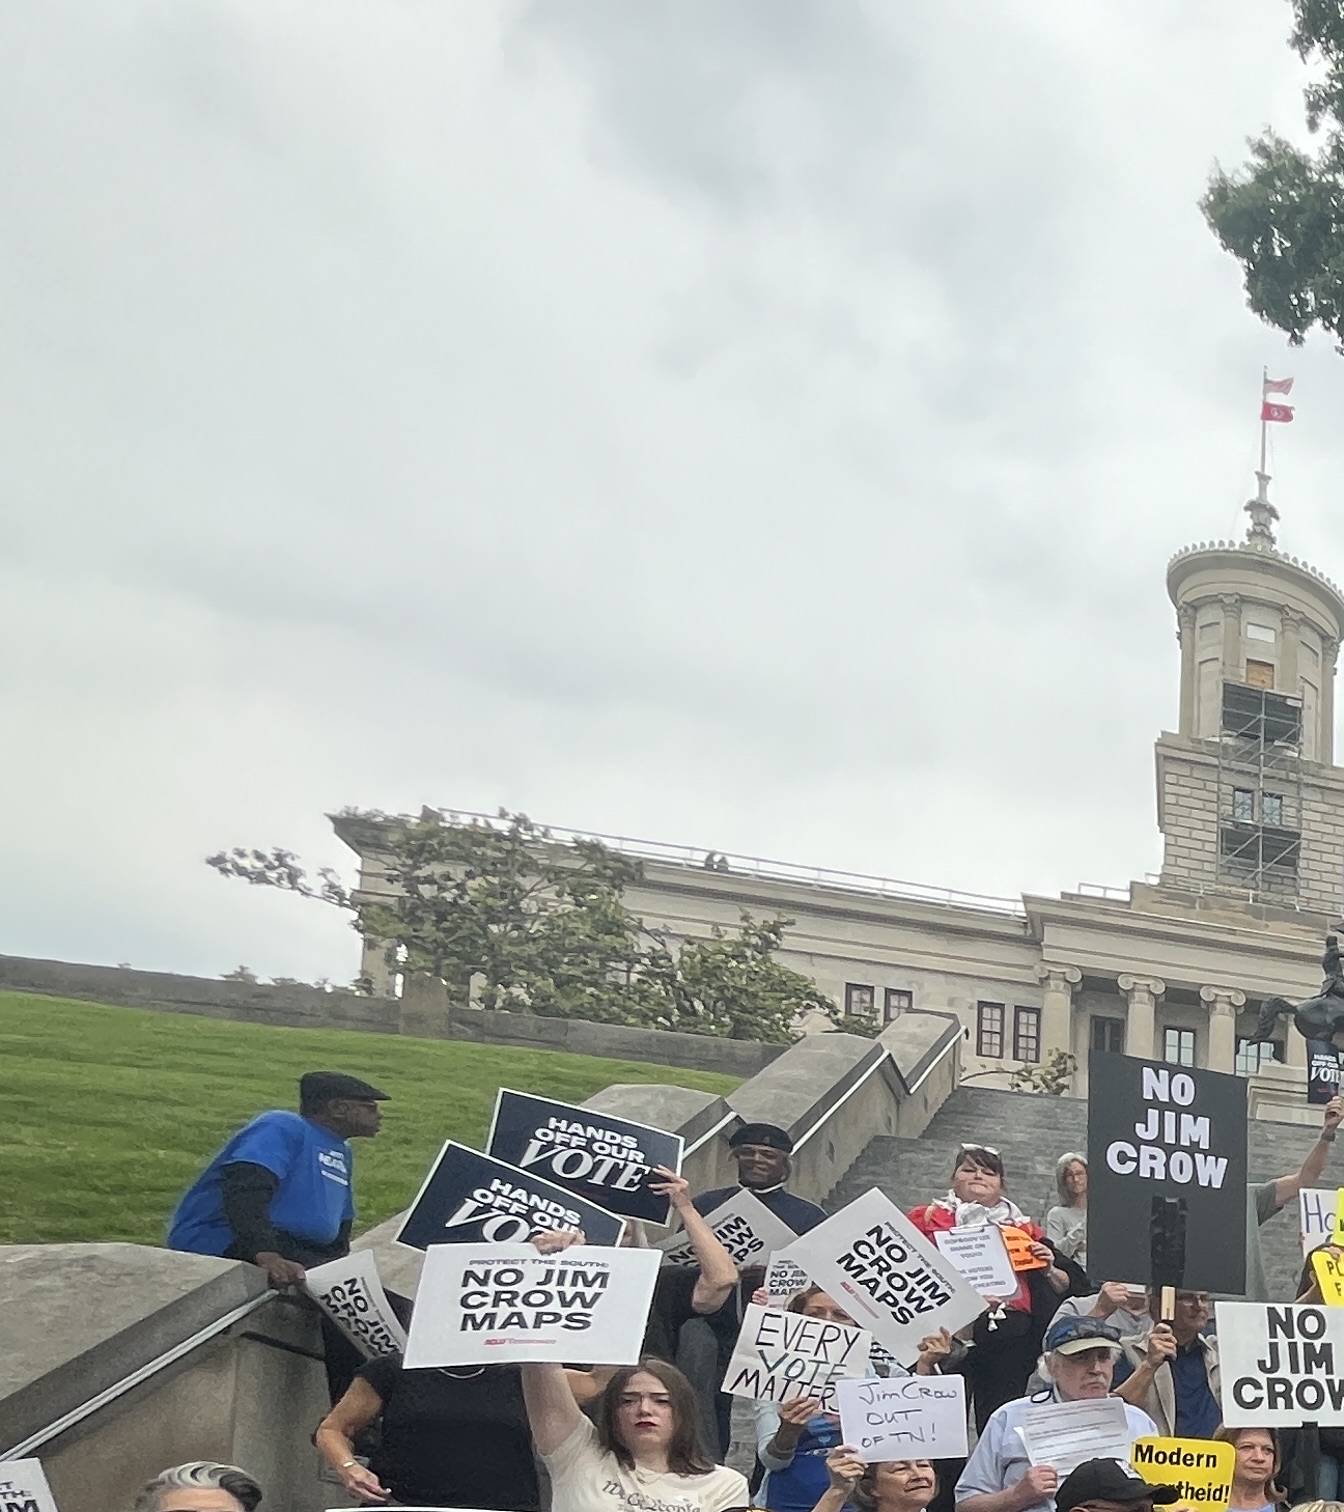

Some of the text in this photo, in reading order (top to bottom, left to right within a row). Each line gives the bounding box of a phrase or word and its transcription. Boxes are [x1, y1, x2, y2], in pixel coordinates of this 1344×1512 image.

[1142, 1066, 1196, 1106] NO
[535, 1127, 646, 1163] OFF OUR
[549, 1117, 638, 1149] HANDS
[1135, 1109, 1211, 1149] JIM
[519, 1139, 652, 1192] VOTE
[1106, 1141, 1229, 1189] CROW
[489, 1179, 581, 1225] HANDS
[461, 1269, 610, 1289] NO JIM
[836, 1252, 915, 1326] MAPS
[850, 1240, 935, 1314] CROW
[459, 1291, 604, 1310] CROW
[459, 1312, 592, 1331] MAPS
[754, 1313, 862, 1360] EVERY
[1267, 1307, 1326, 1341] NO
[758, 1349, 847, 1385] VOTE
[1257, 1342, 1334, 1375] JIM
[861, 1423, 938, 1448] OF TN!
[866, 1410, 923, 1426] OUT
[1133, 1444, 1218, 1468] Modern
